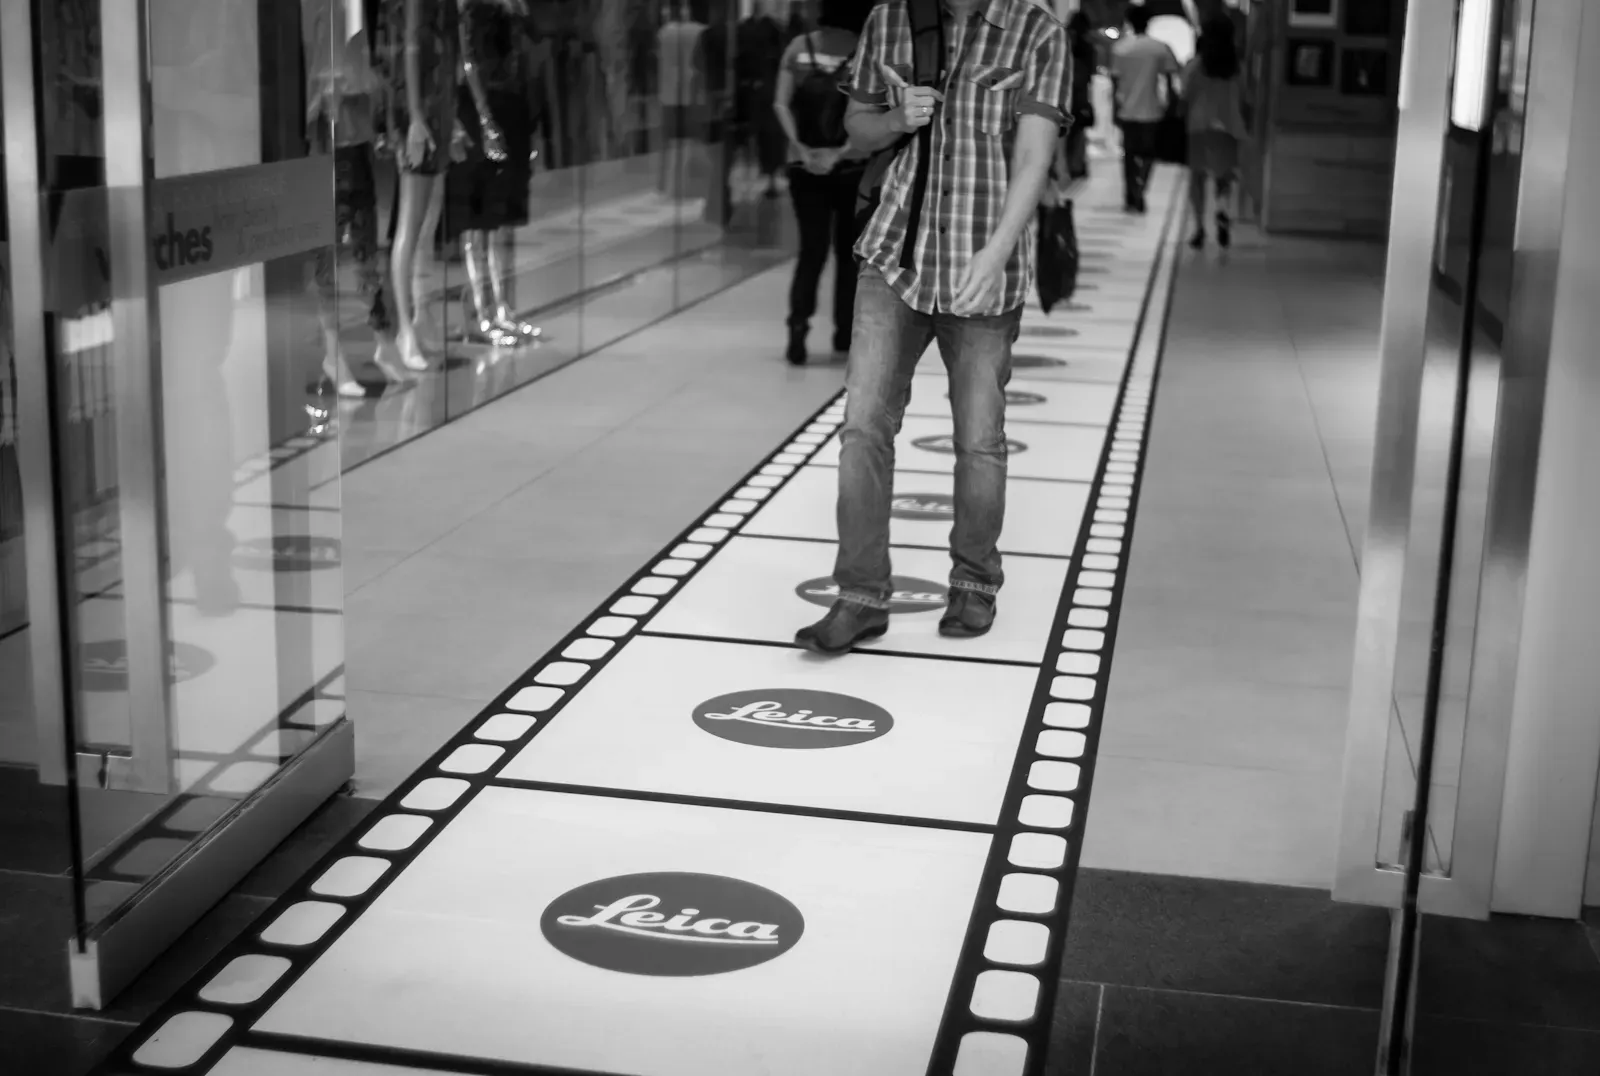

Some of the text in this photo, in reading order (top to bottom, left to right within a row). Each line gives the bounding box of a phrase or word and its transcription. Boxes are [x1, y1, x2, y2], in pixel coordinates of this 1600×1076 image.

[152, 212, 214, 271] ches
[703, 700, 876, 733] Leica
[556, 893, 780, 945] Leica
